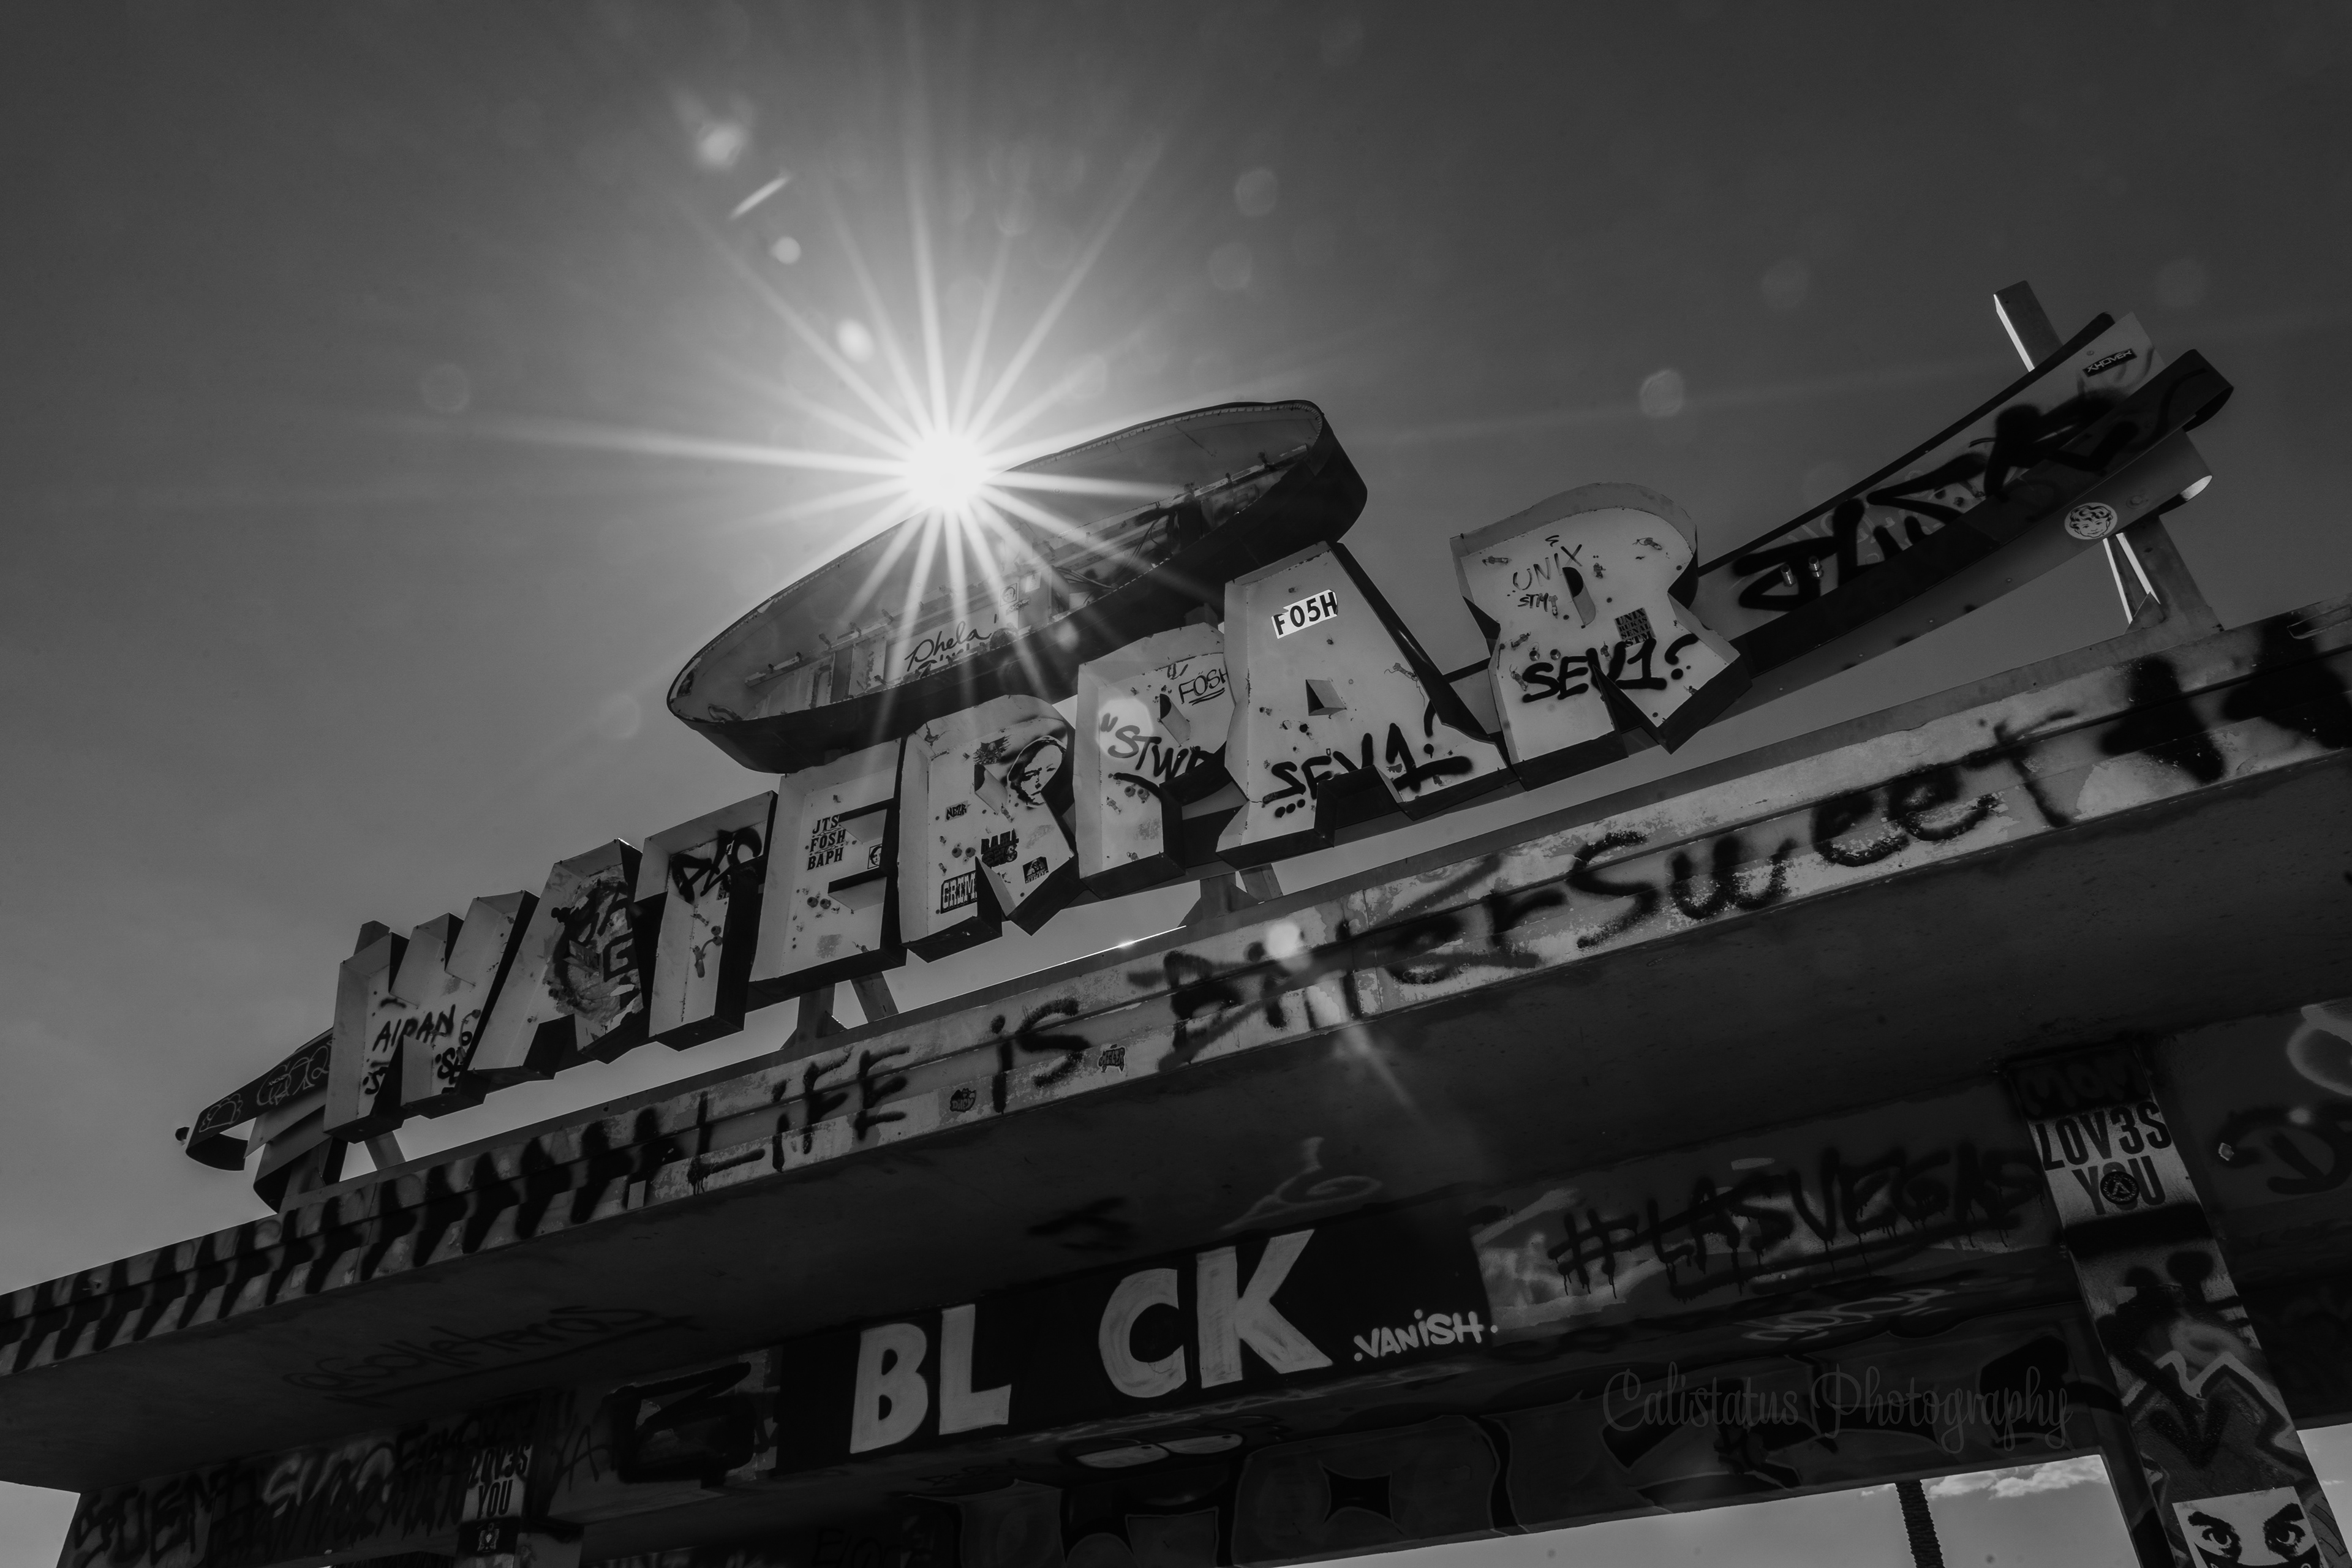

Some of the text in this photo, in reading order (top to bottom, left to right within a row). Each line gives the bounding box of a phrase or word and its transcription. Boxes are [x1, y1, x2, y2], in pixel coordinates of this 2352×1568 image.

[809, 830, 846, 853] FOSH
[807, 846, 843, 872] BAPH
[941, 871, 979, 911] GRIM
